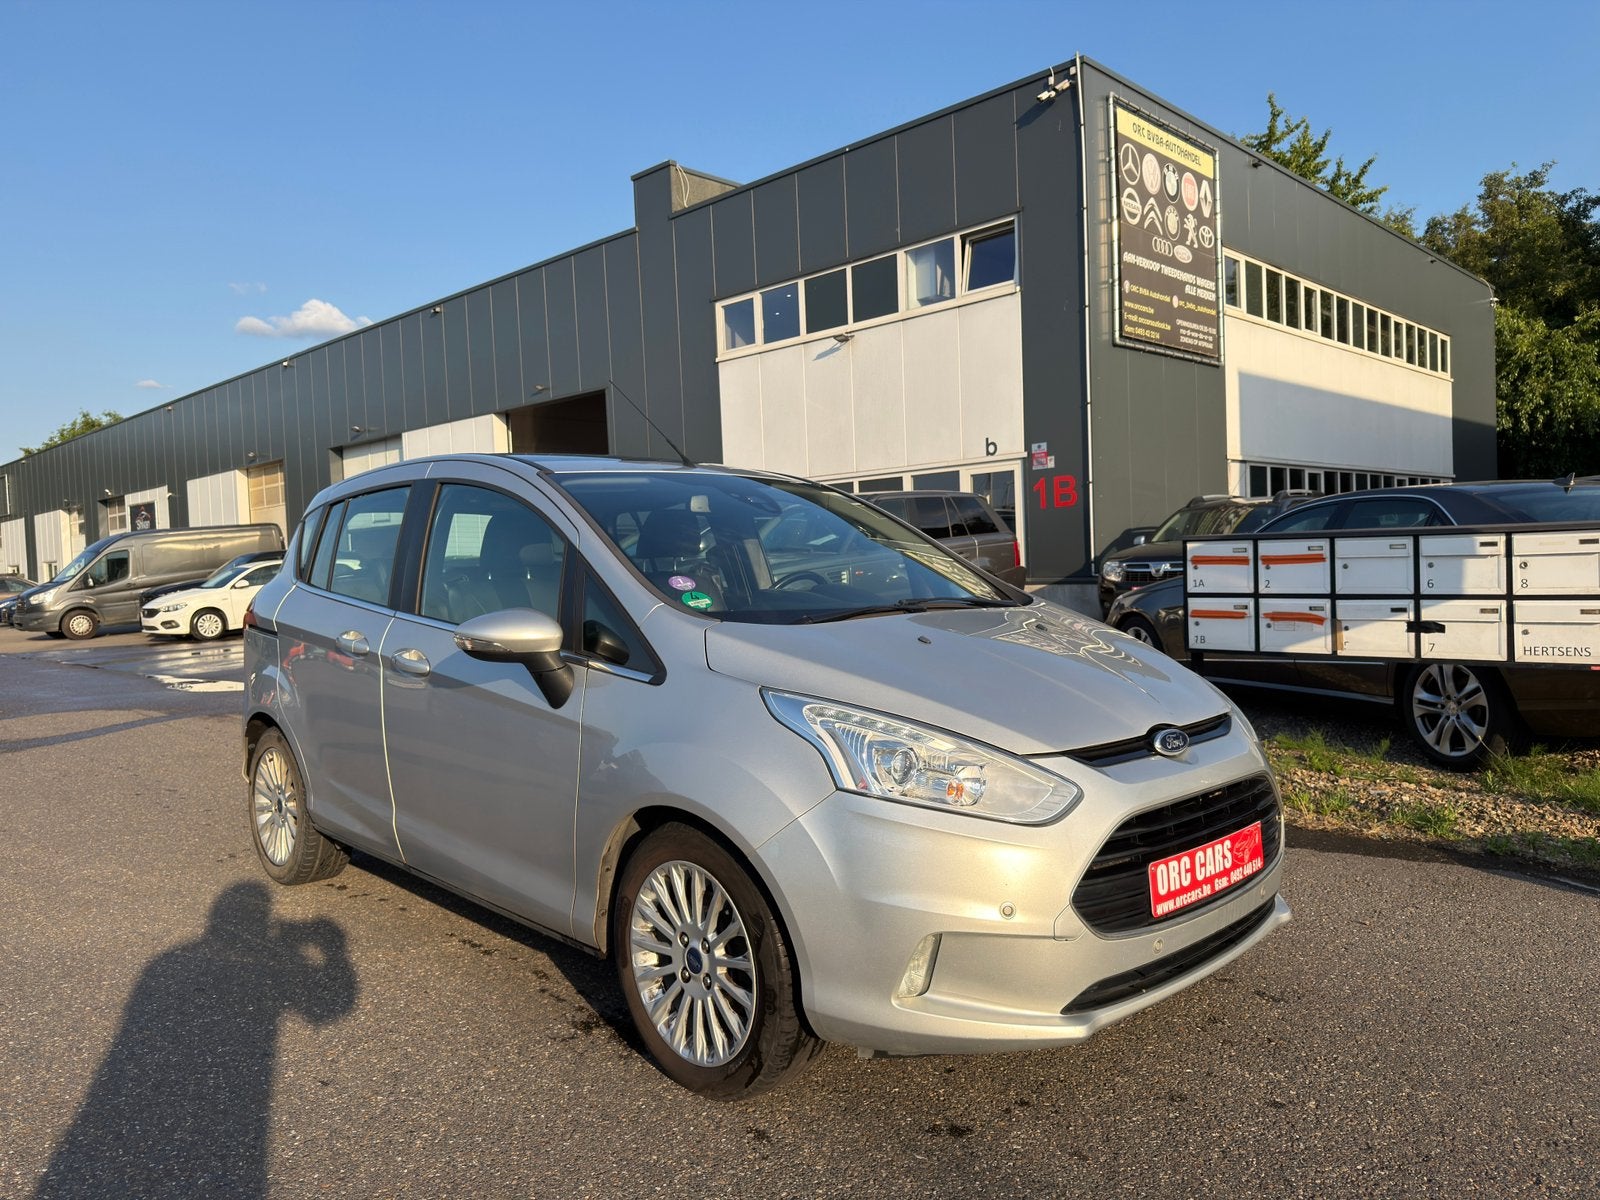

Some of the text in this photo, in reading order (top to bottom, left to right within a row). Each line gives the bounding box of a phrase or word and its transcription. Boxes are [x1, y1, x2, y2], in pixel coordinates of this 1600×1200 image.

[1132, 122, 1201, 166] ORC BVBA-AUTOHANDEL
[1161, 264, 1196, 284] TWEEDEHANDS
[1185, 284, 1196, 296] ALLE
[985, 437, 998, 456] b
[1033, 474, 1078, 510] 1B
[1193, 579, 1205, 588] 1A
[1264, 579, 1271, 588] 2
[1427, 578, 1434, 589] 6
[1520, 578, 1529, 589] 8
[1428, 642, 1436, 652] 7
[1523, 645, 1592, 657] HERTSENS
[1165, 733, 1185, 749] Ford
[1156, 839, 1233, 897] ORC CARS
[1156, 883, 1212, 916] www.orccars.be
[1214, 875, 1229, 893] Gsm:
